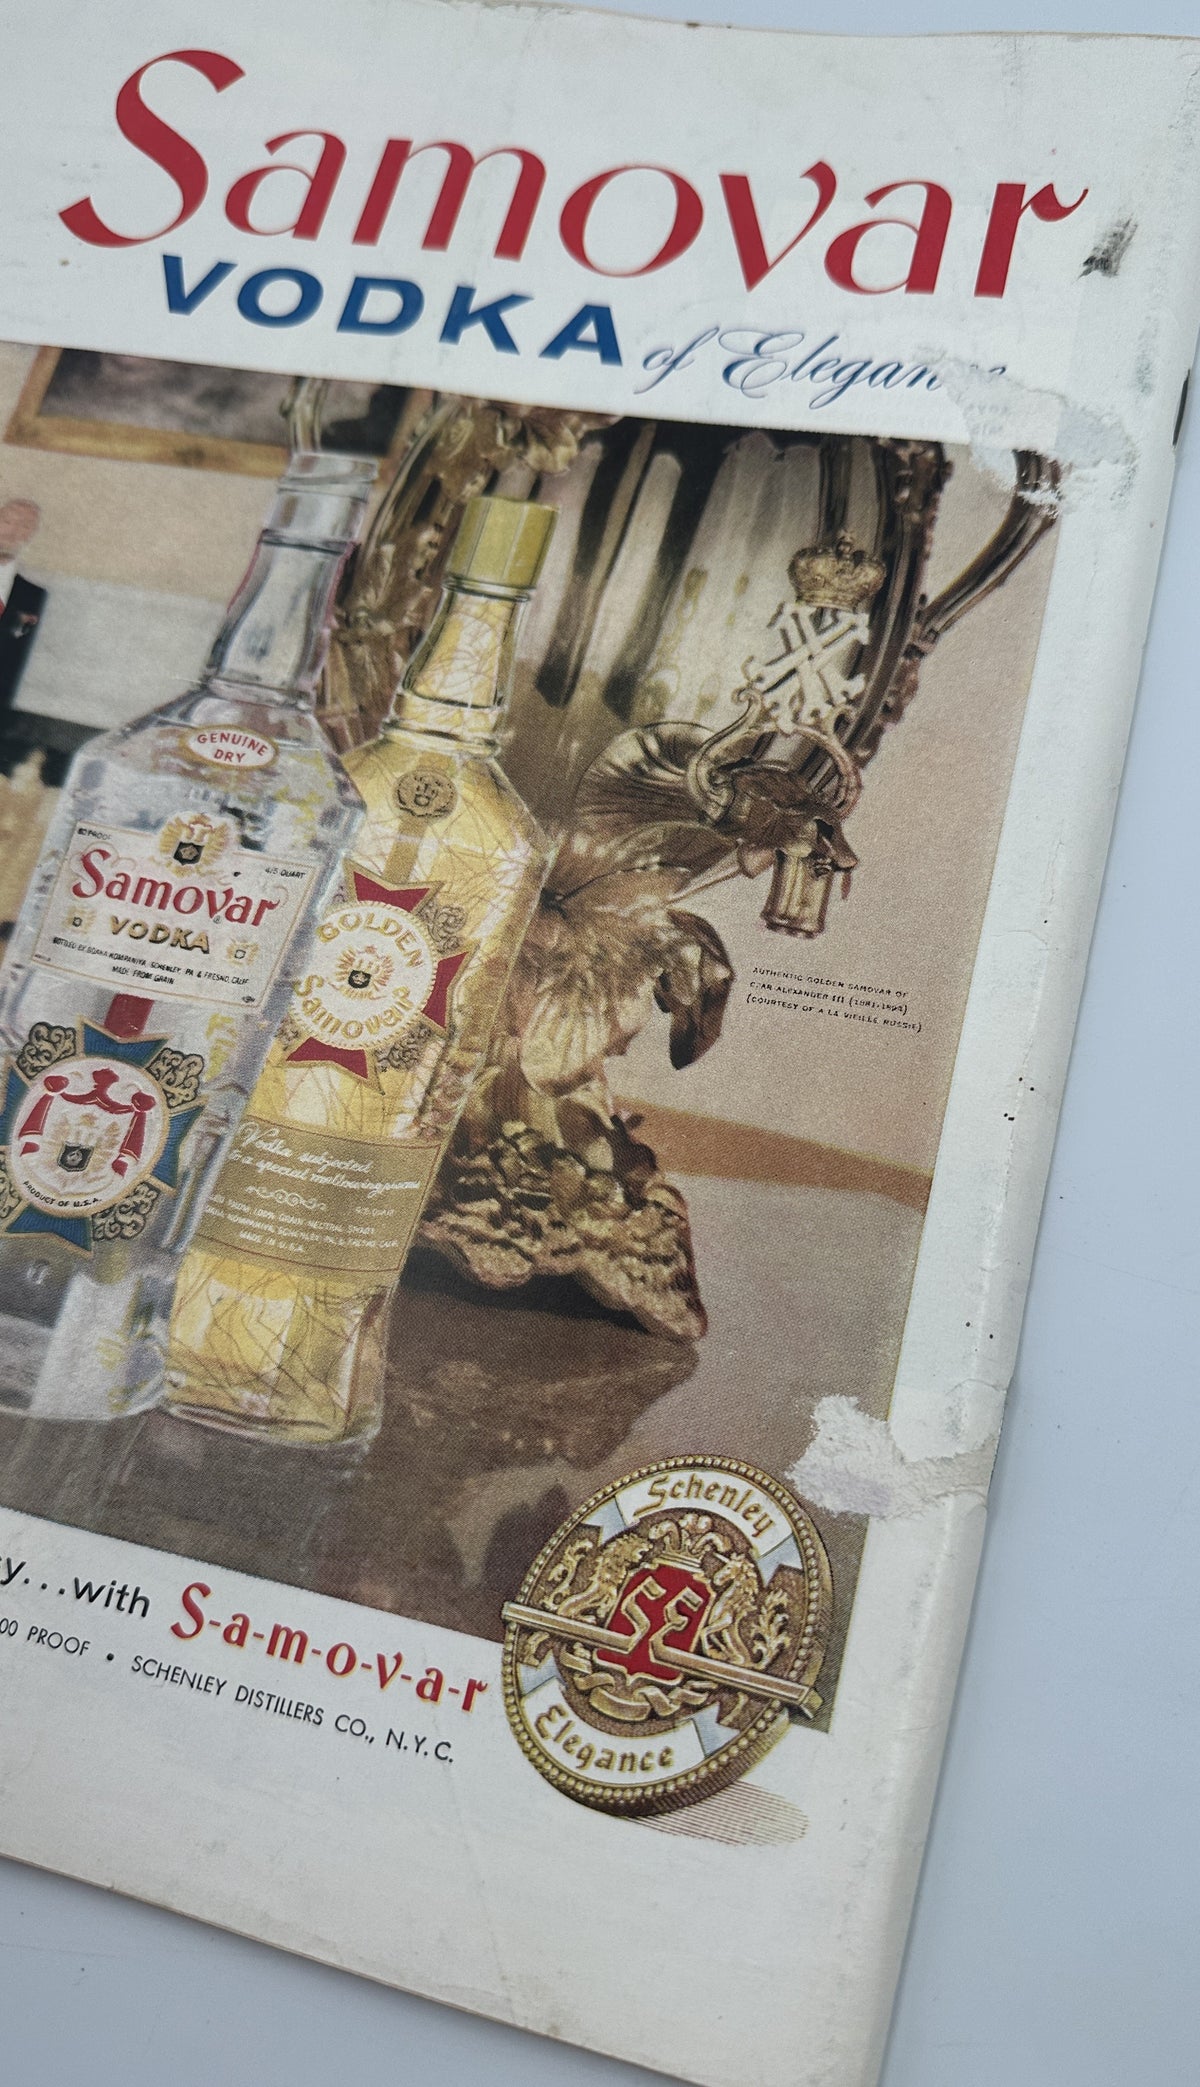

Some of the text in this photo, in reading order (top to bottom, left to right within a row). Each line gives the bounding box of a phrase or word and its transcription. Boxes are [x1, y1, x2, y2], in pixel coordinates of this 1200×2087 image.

[58, 49, 1089, 300] Samovar
[161, 253, 1006, 410] VODKA of Elegan
[197, 732, 268, 756] GENUINE
[214, 749, 246, 763] DRY
[72, 849, 281, 926] Samovar
[110, 915, 211, 955] VODKA
[316, 912, 425, 969] GOLDEN
[294, 974, 414, 1039] Samovar
[746, 993, 799, 1010] (COURTESY
[752, 967, 803, 982] AUTHENTIC
[807, 976, 844, 988] GOLDEN
[847, 984, 891, 996] SAMOVAR
[775, 986, 829, 1000] ALEXANDER
[23, 1180, 56, 1205] PRODUCT
[57, 1200, 69, 1208] OF
[633, 1474, 777, 1538] Schenley
[170, 1581, 489, 1713] S-a-m-o-v-a-r
[26, 1625, 92, 1656] PROOF
[130, 1654, 228, 1697] SCHENLEY
[234, 1684, 324, 1727] DISTILLERS
[334, 1713, 376, 1744] CO.,
[385, 1727, 455, 1763] N.Y.C.
[534, 1704, 676, 1774] Elegance
